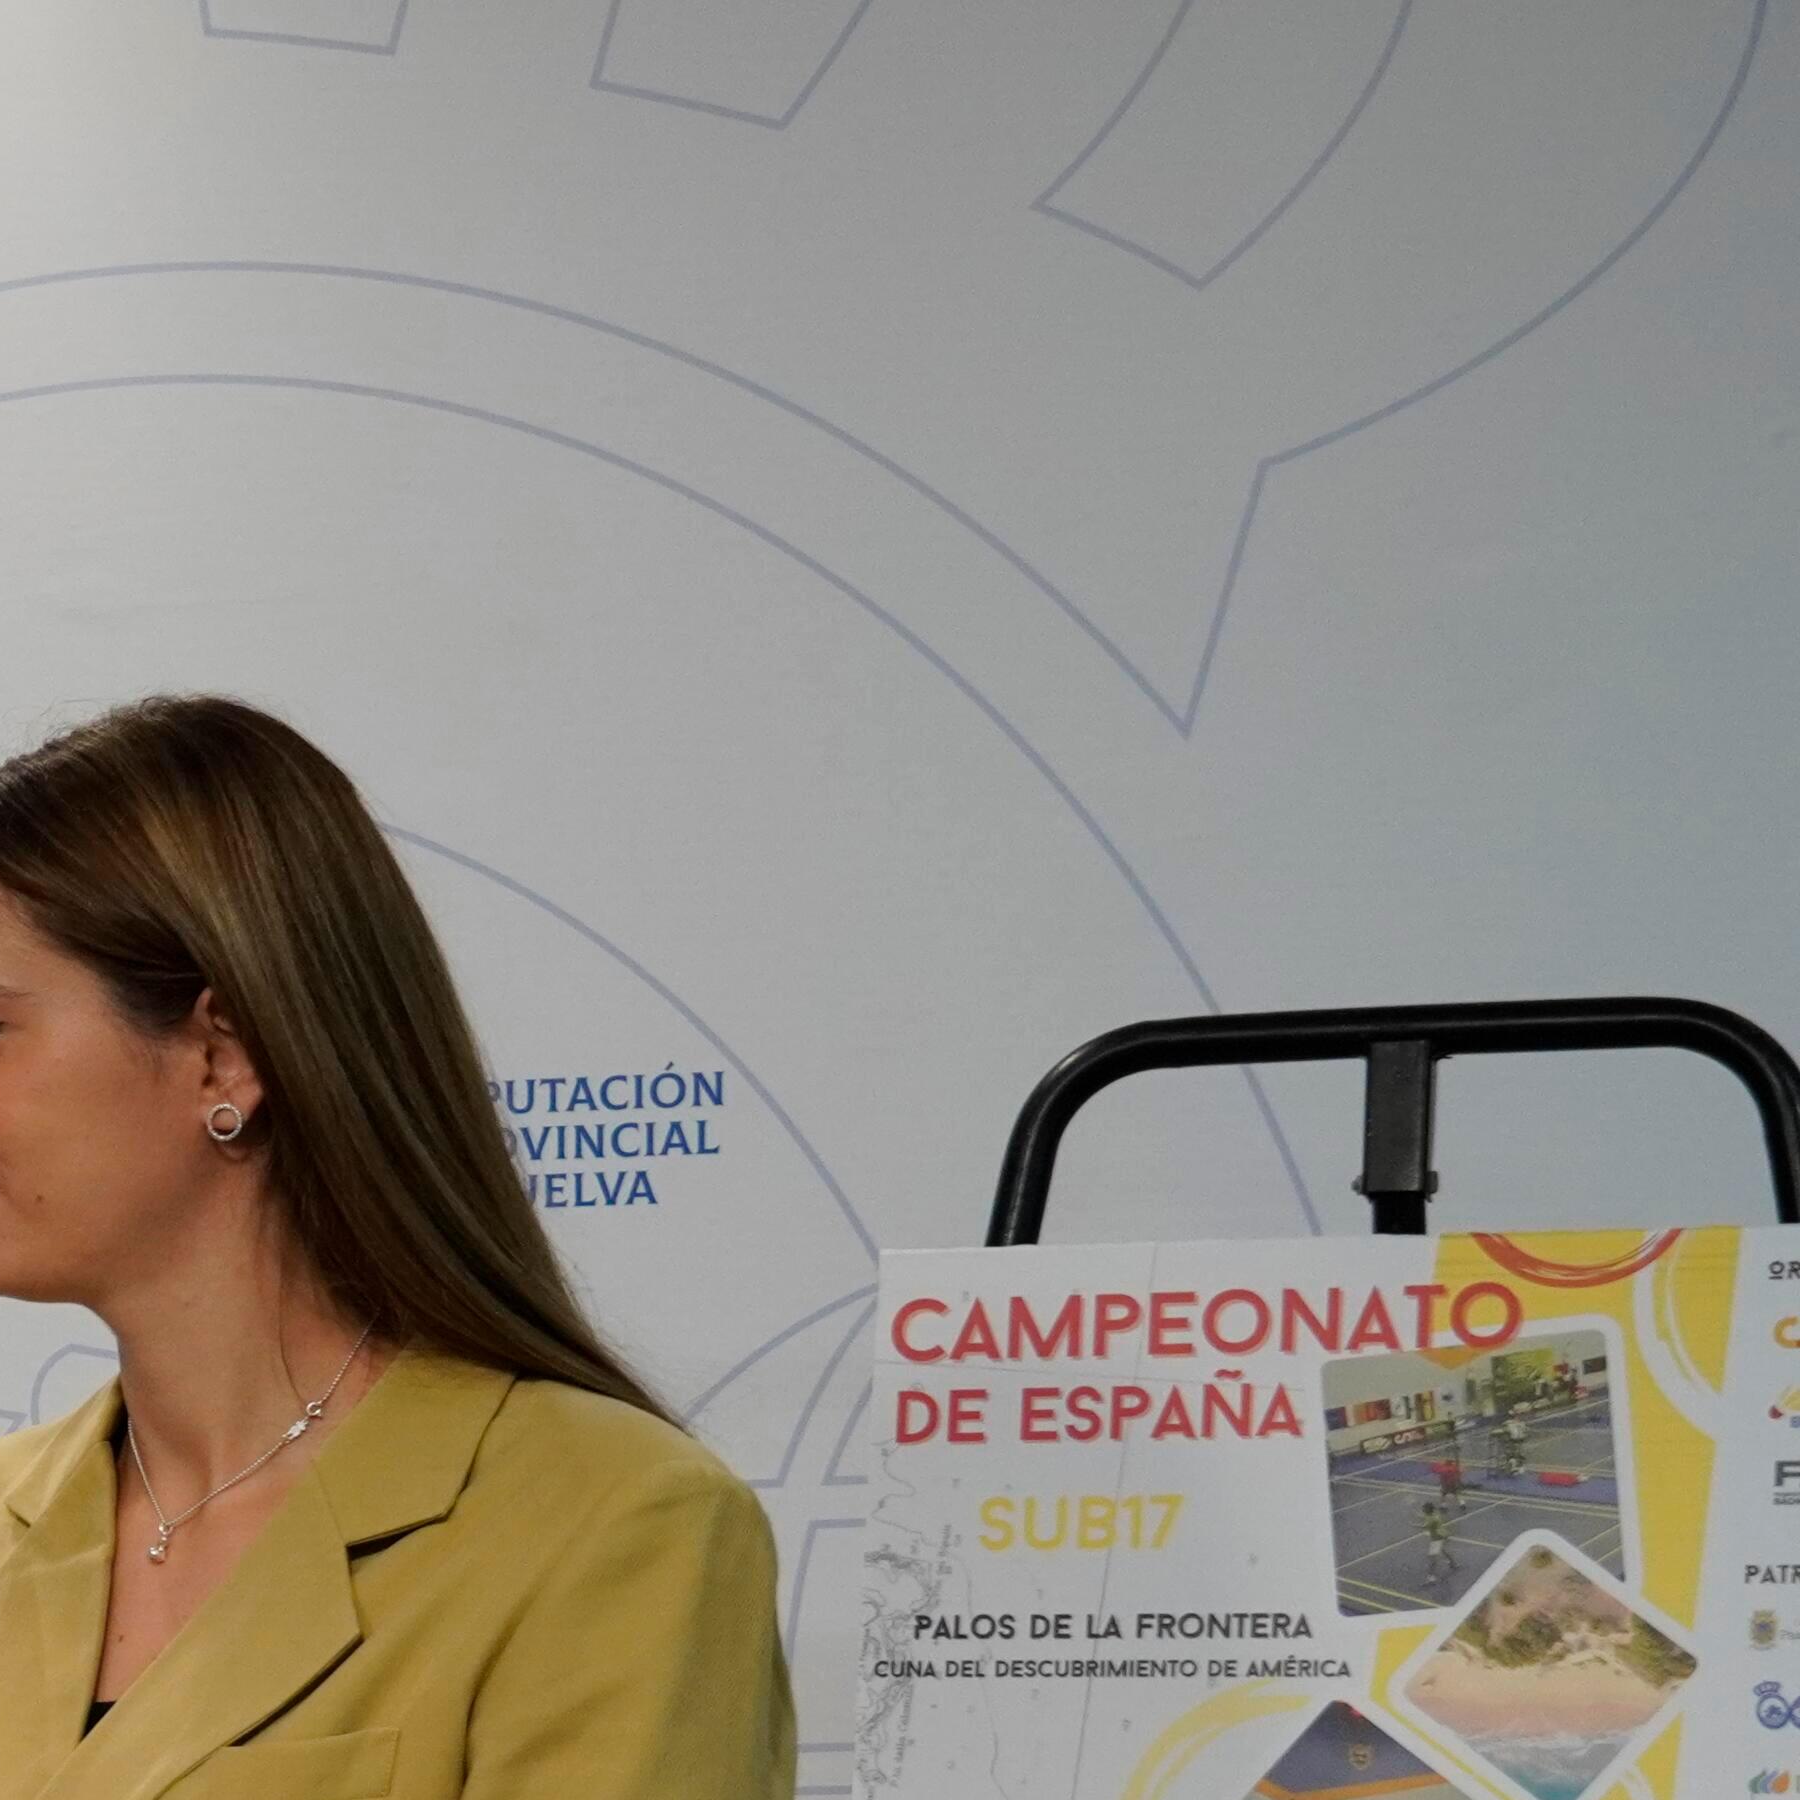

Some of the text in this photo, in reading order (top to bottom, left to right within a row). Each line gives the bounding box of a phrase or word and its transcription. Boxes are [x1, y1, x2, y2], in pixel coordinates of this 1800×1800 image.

[890, 1280, 1523, 1365] CAMPEONATO
[894, 1368, 1304, 1444] DE ESPAÑA
[978, 1493, 1183, 1552] SUB17
[914, 1612, 1313, 1641] PALOS DE LA FRONTERA
[874, 1655, 1352, 1678] CUNA DEL DESCUBRIMIENTO DE AMÉRICA
